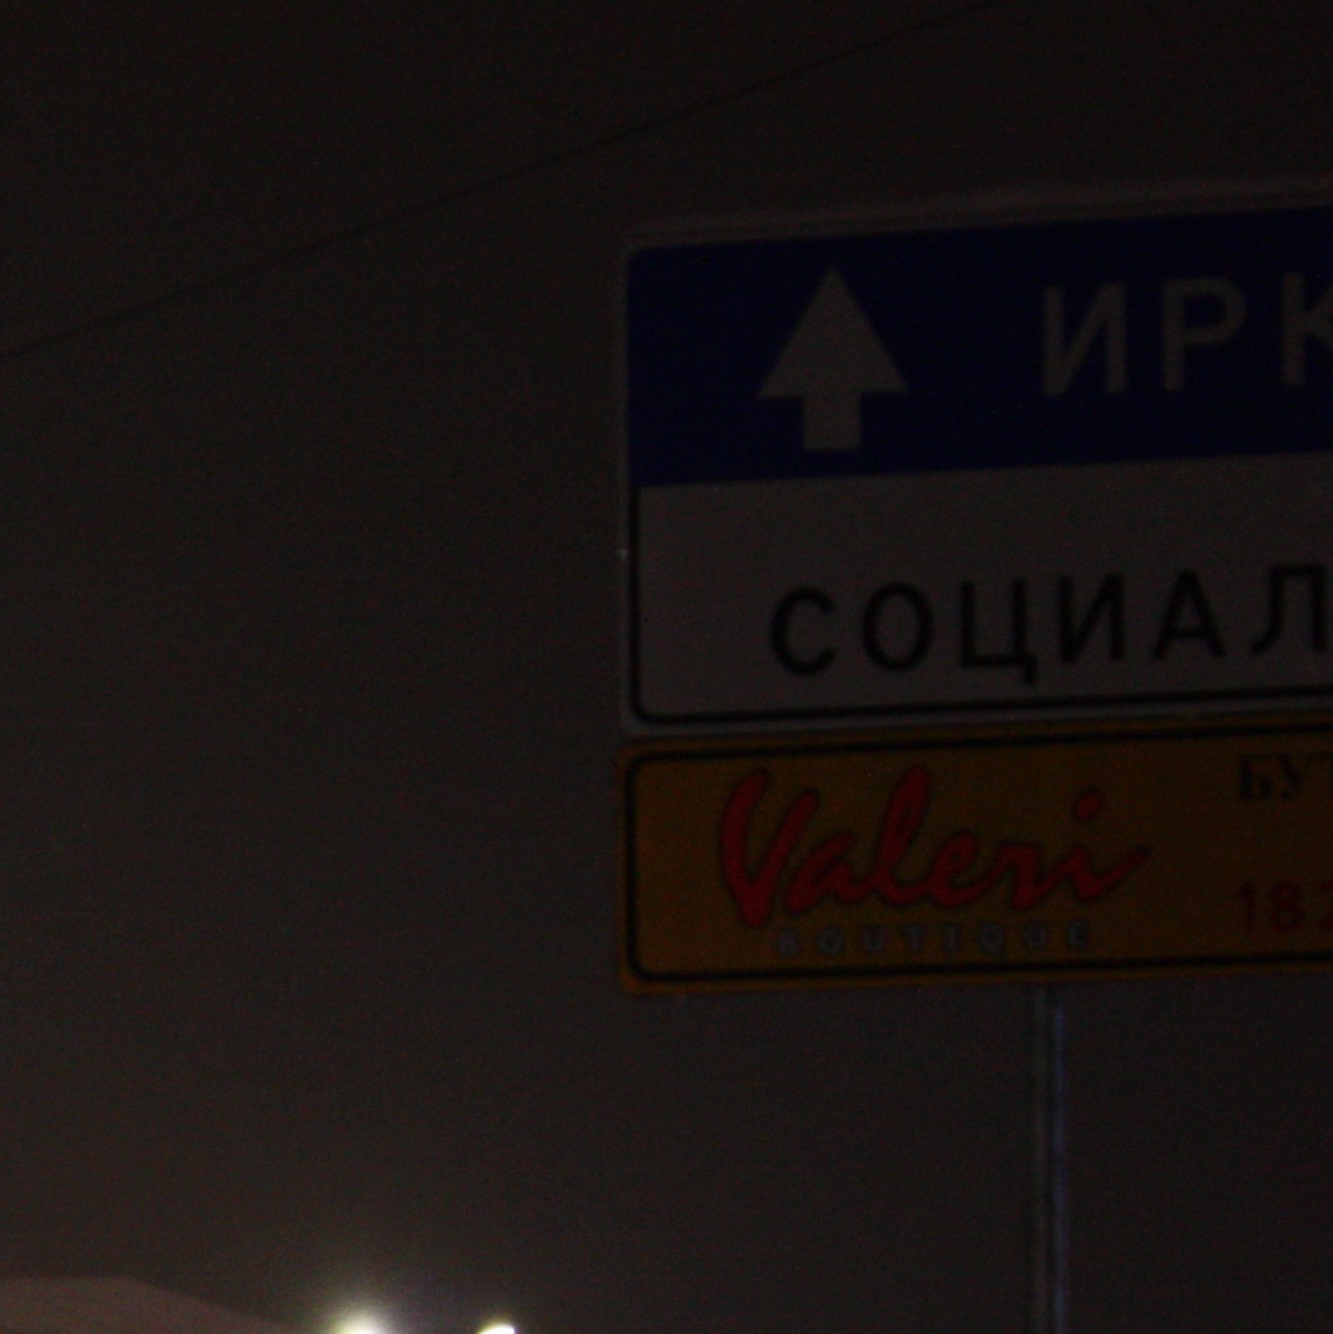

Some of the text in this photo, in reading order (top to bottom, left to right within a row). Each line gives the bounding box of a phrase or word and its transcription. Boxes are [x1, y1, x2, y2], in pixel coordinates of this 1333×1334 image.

[1040, 271, 1333, 397] ИРК
[769, 562, 1329, 684] СОЦИАЛ
[717, 764, 1152, 927] Valeri
[777, 920, 1091, 957] BOUTIQUE
